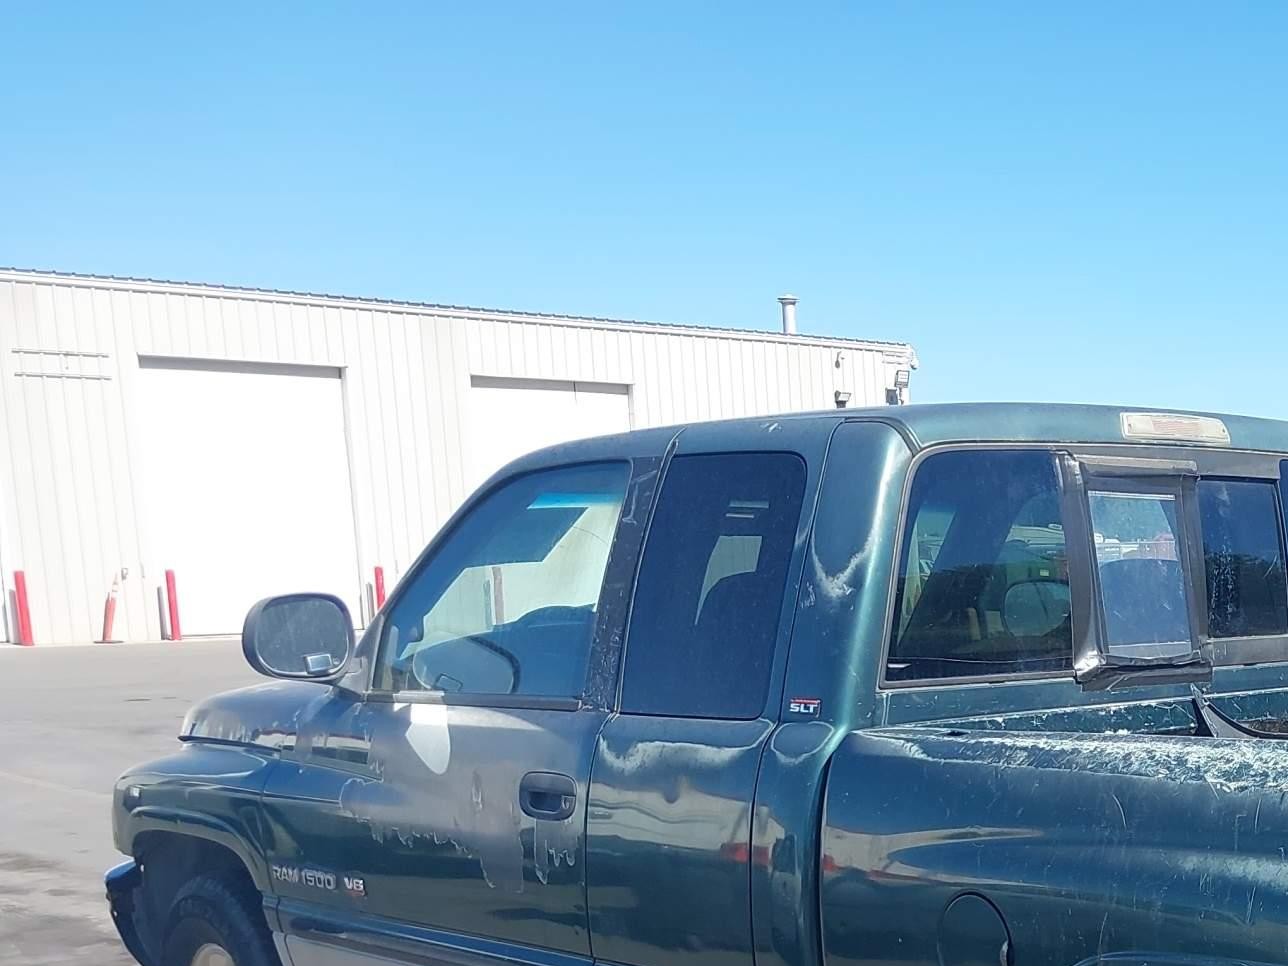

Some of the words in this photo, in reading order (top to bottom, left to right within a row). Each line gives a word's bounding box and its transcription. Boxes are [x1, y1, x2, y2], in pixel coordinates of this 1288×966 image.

[789, 703, 818, 713] SLT
[272, 866, 299, 883] RAM
[301, 869, 337, 890] 1500
